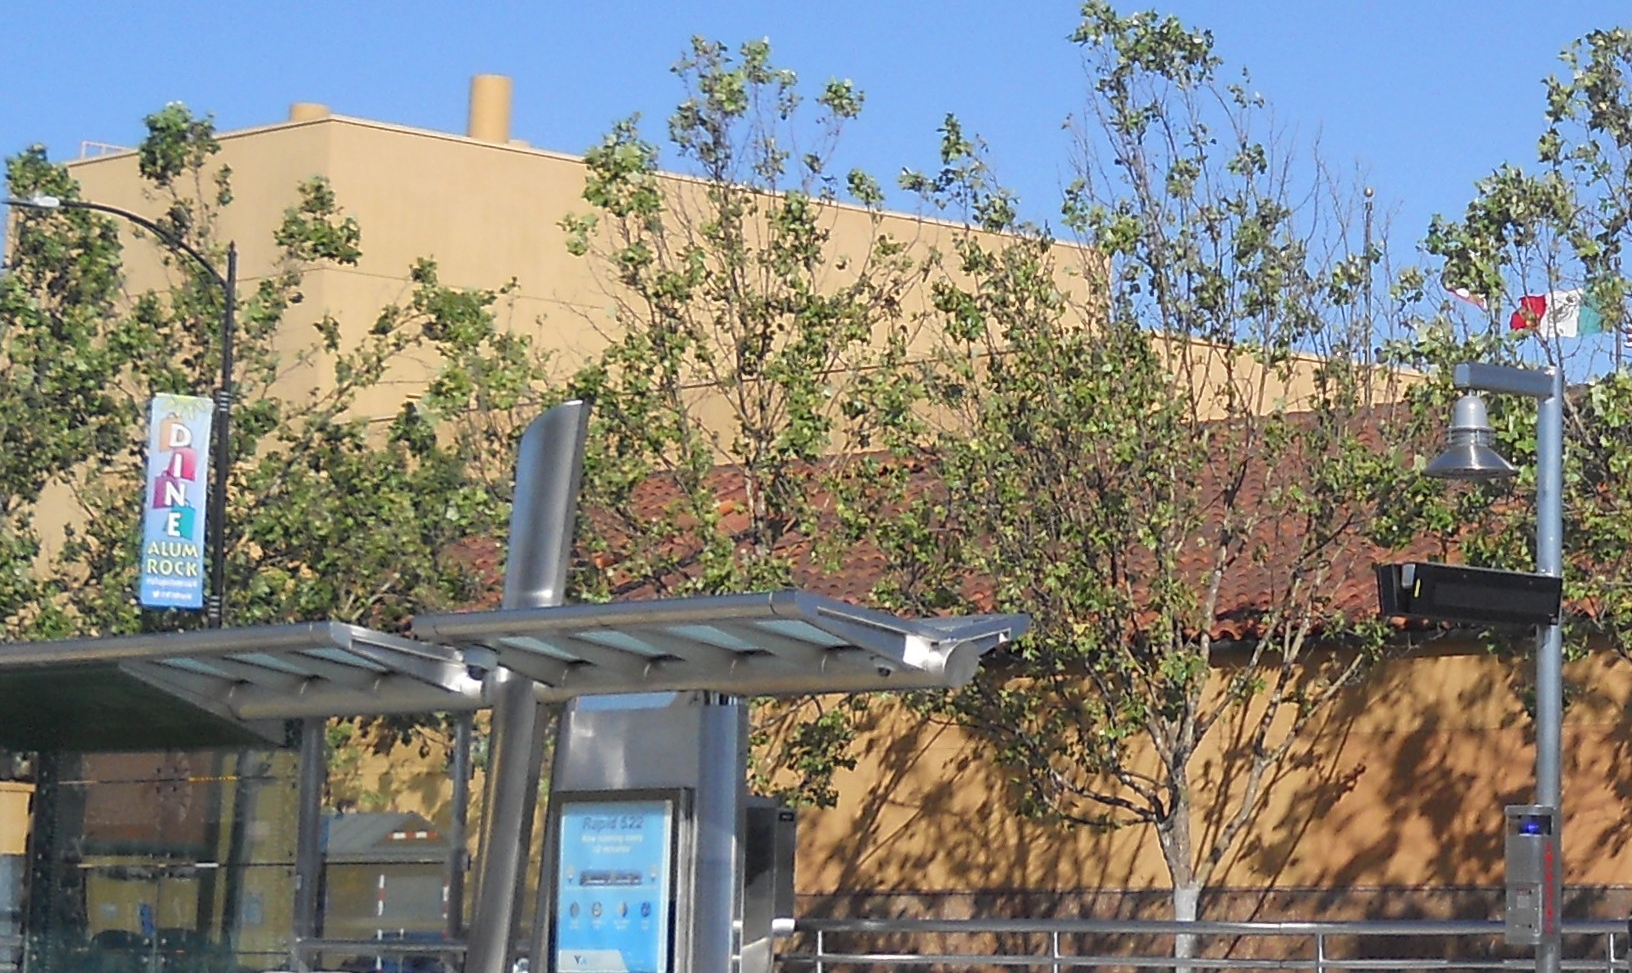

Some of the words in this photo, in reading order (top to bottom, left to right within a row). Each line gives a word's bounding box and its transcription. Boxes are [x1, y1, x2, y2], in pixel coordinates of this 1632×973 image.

[164, 423, 192, 537] DINE
[147, 541, 199, 558] ALUM
[147, 558, 198, 577] ROCK
[582, 816, 618, 832] Rapid
[620, 813, 644, 829] 522
